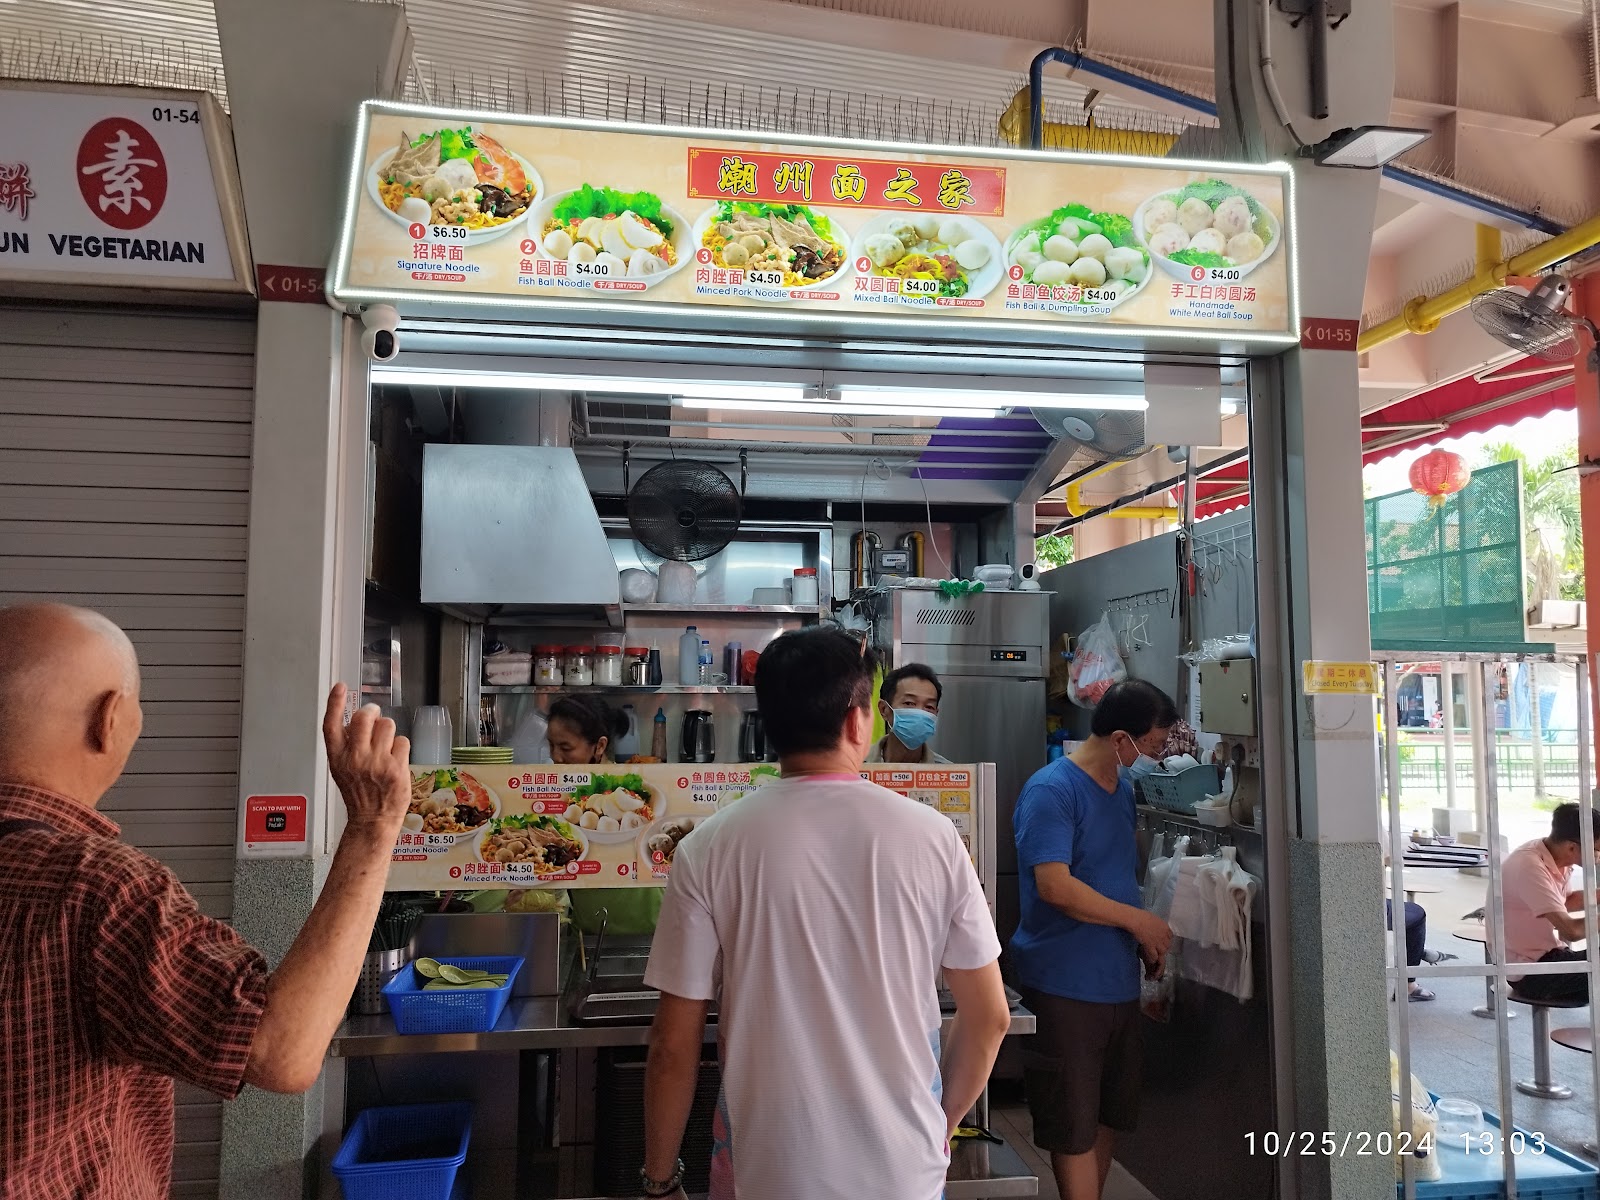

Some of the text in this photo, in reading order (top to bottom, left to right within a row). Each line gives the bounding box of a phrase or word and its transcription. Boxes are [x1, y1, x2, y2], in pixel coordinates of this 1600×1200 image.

[152, 107, 200, 124] 01-54
[82, 129, 158, 216] 素
[719, 157, 975, 208] 潮州面之家
[433, 226, 467, 239] $6.50
[0, 232, 205, 263] UN VEGETARIAN
[413, 242, 464, 262] 招牌面
[397, 260, 480, 273] Signature Noodle
[519, 259, 568, 277] 鱼圆面
[576, 263, 609, 275] $4.00
[696, 267, 744, 286] 肉脞面
[750, 271, 781, 285] $4.50
[1211, 269, 1240, 281] $4.00
[518, 276, 591, 289] Fish Ball Noodle
[854, 277, 899, 294] 双圆面
[905, 280, 937, 292] $4.00
[696, 286, 788, 298] Minced Pork Noodle
[811, 292, 837, 300] DRY/SOUP
[1007, 284, 1081, 302] 鱼圆鱼饺汤
[1087, 290, 1117, 302] $4.00
[1171, 284, 1257, 302] 手工白肉圆汤
[853, 293, 932, 306] Mixed Ball Noodle
[1189, 300, 1235, 310] Handmade
[1005, 301, 1021, 310] Fish
[1048, 304, 1088, 314] Dumpling
[1090, 306, 1111, 314] Soup
[1169, 309, 1253, 321] White Meat Ball Soup
[1316, 327, 1352, 343] 01-55
[522, 773, 558, 785] 鱼圆面
[562, 774, 589, 784] $4.00
[692, 771, 750, 784] 鱼圆鱼饺汤
[918, 773, 948, 781] 打包盒子
[692, 793, 718, 802] $4.00
[428, 835, 455, 844] $6.50
[392, 846, 420, 854] gnature
[464, 863, 501, 875] 肉脞面
[506, 864, 533, 873] $4.50
